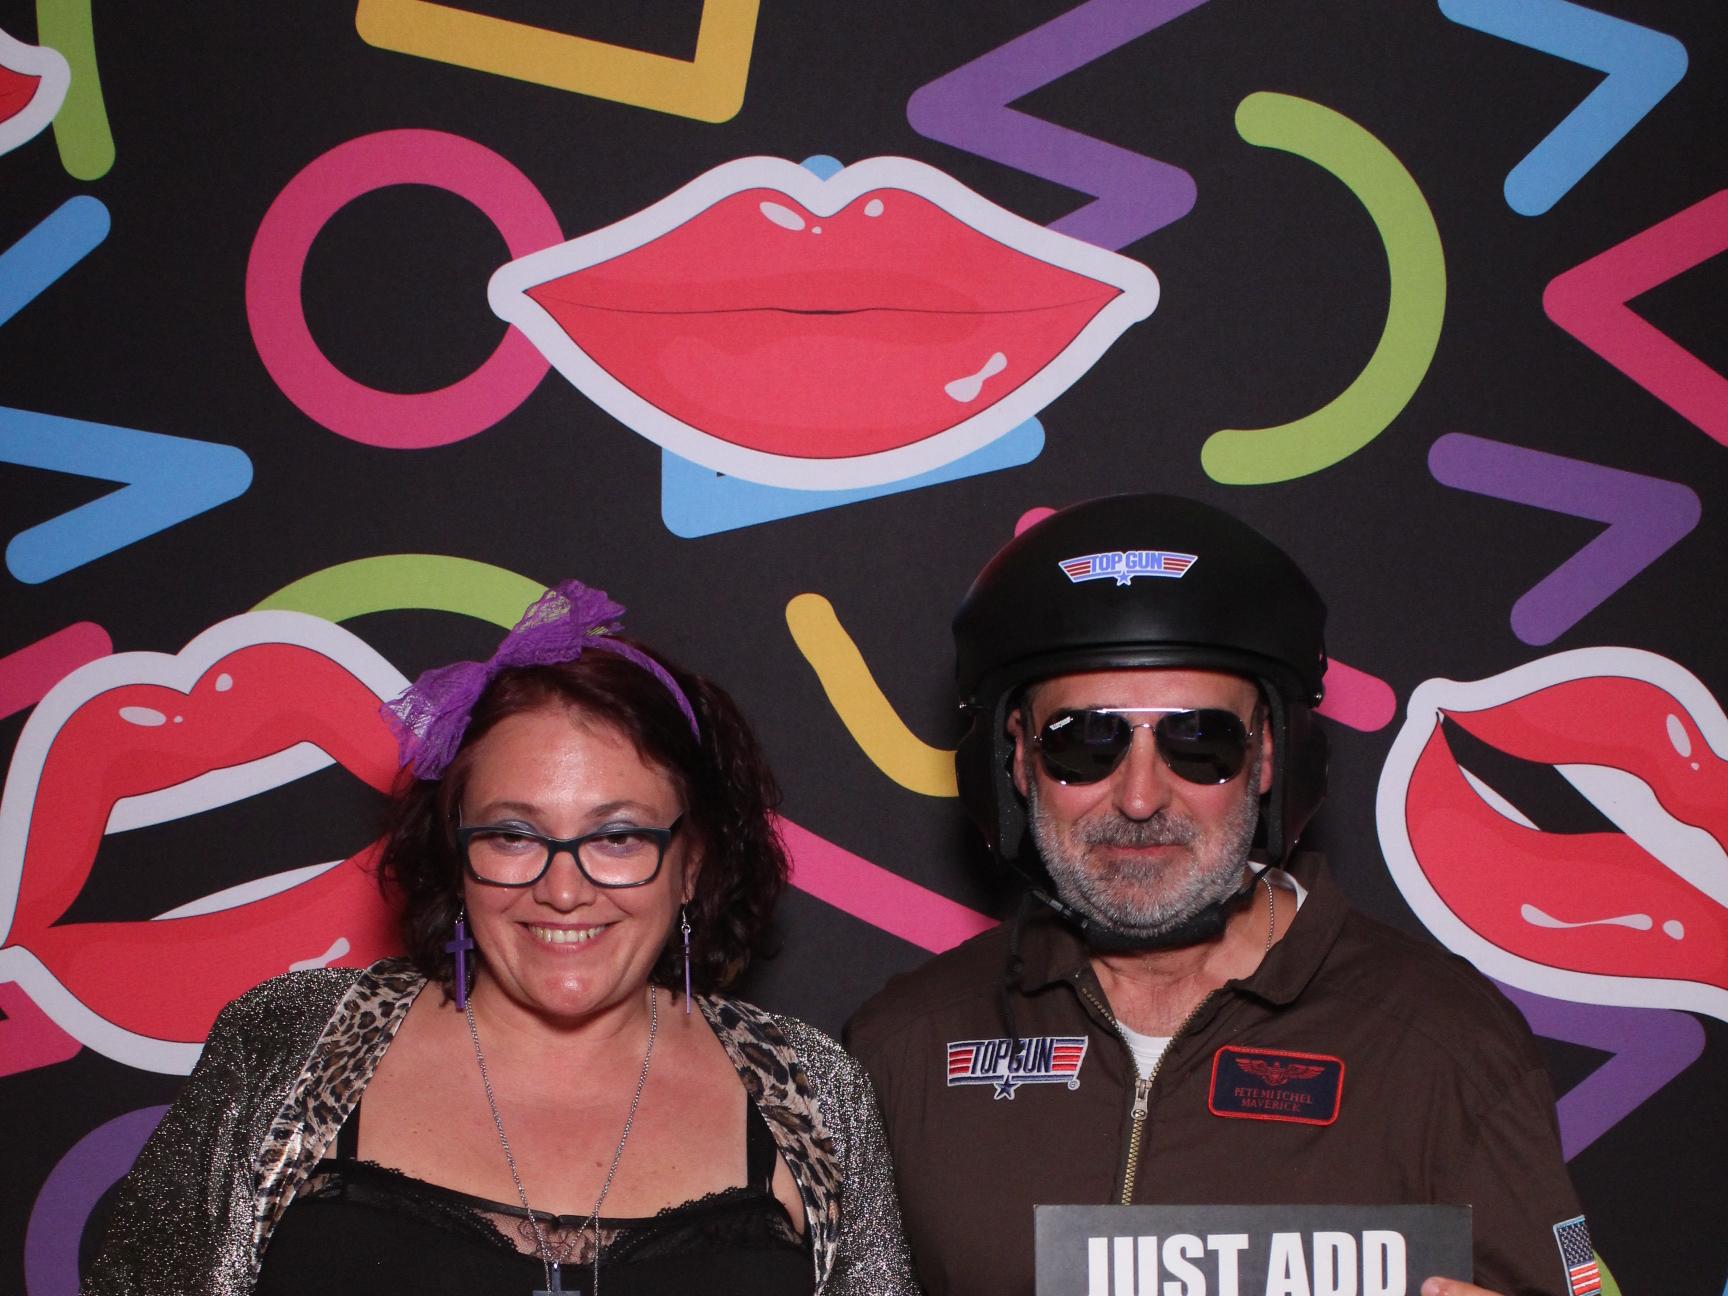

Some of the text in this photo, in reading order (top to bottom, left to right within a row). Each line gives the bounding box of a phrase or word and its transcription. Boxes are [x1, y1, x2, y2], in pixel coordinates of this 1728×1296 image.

[1090, 552, 1163, 574] TOP GUN
[971, 1037, 1055, 1074] TOP GUN
[1241, 1098, 1300, 1112] MAVERICK
